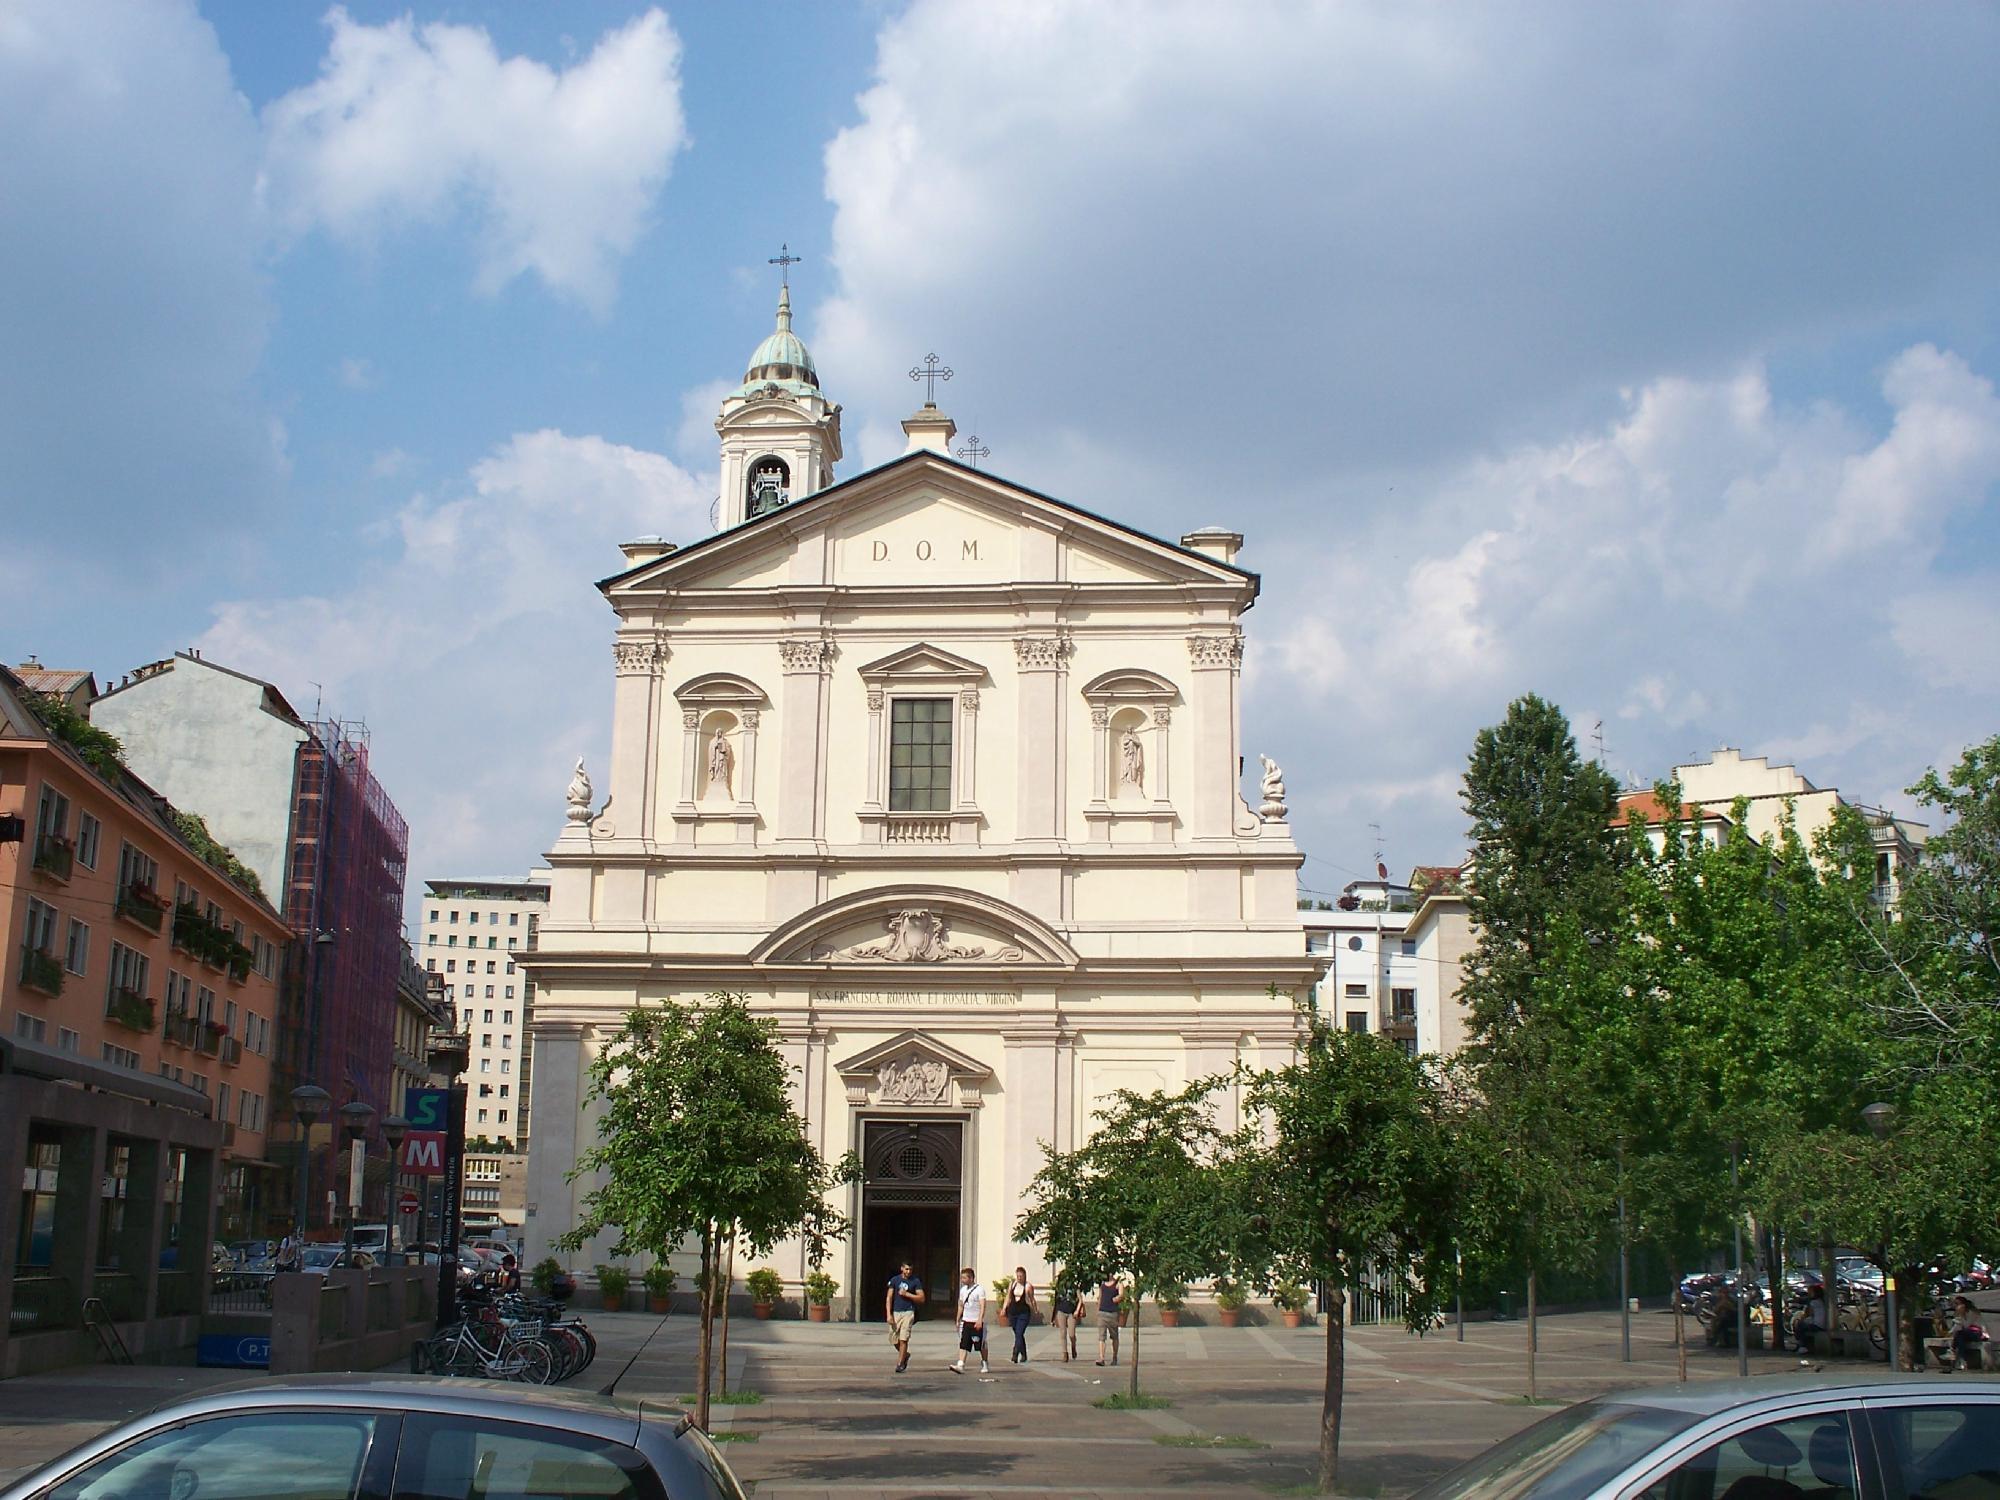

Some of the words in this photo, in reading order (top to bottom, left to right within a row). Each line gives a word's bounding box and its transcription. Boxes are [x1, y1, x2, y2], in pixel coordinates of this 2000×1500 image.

[928, 992, 937, 1004] ET
[412, 1095, 440, 1125] S
[406, 1139, 440, 1168] M
[447, 1156, 456, 1191] Venezia
[445, 1194, 454, 1216] Porta
[443, 1217, 453, 1248] Milano
